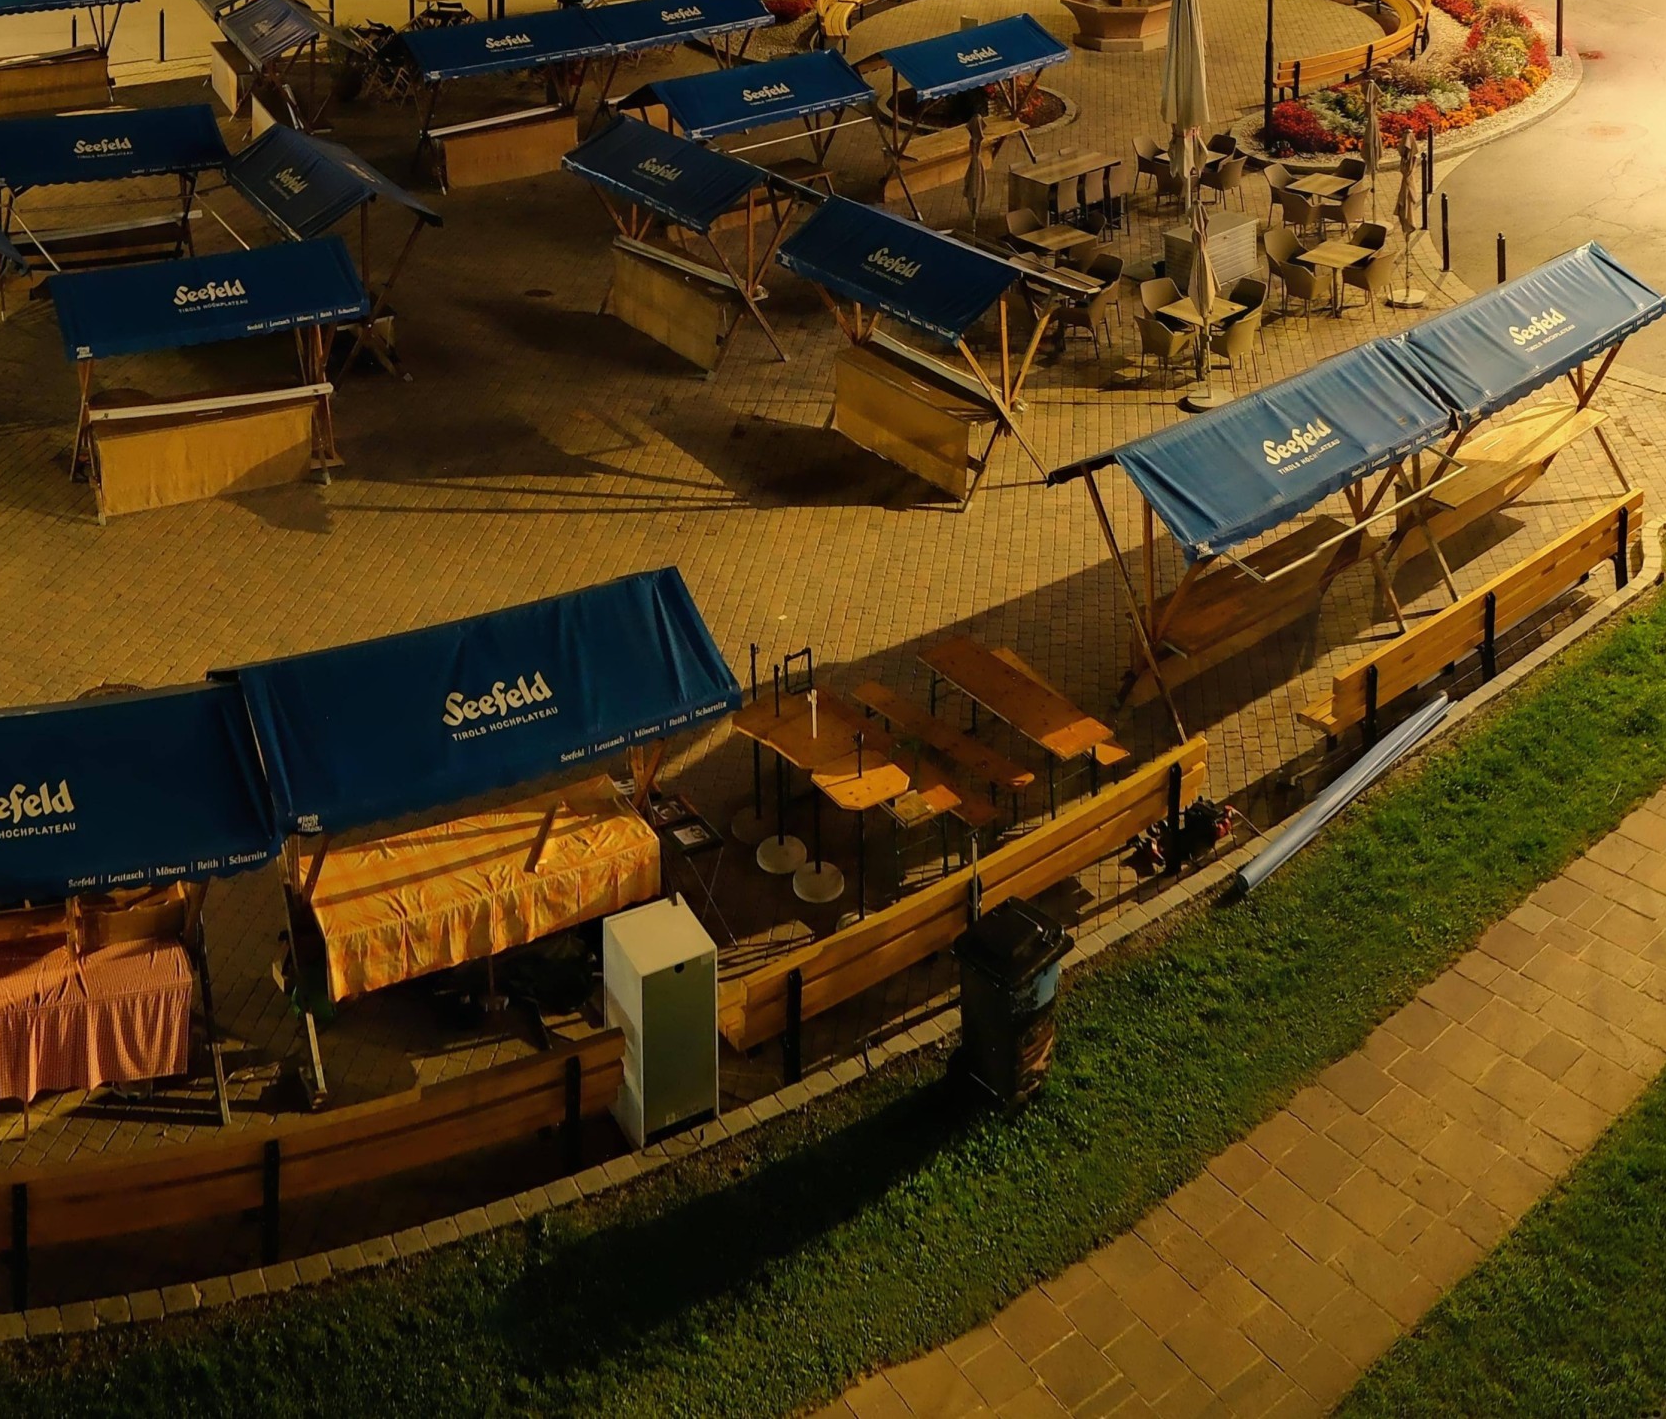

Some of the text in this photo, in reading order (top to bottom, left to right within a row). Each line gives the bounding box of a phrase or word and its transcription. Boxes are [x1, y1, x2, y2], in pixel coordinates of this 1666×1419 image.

[661, 6, 702, 22] Seefeld
[485, 33, 531, 49] Seefeld
[956, 46, 999, 65] Seefeld
[742, 82, 791, 102] Seefeld
[73, 137, 132, 154] Seefeld
[274, 167, 308, 196] Seefeld
[637, 156, 683, 182] Seefeld
[867, 247, 922, 278] Seefeld
[173, 278, 246, 306] Seefeld
[178, 298, 249, 315] TIROLS HOCHPLATEAU
[1508, 307, 1567, 346] Seefeld
[1262, 416, 1333, 466] Seefeld
[441, 670, 554, 728] Seefeld
[452, 705, 559, 743] TIROLS HOCHPLATEAU
[560, 700, 727, 764] Seefeld Leutasch Mösern Reith Scharnitz
[67, 850, 268, 889] Seefeld Leutasch Mösern Reith Scharnitz
